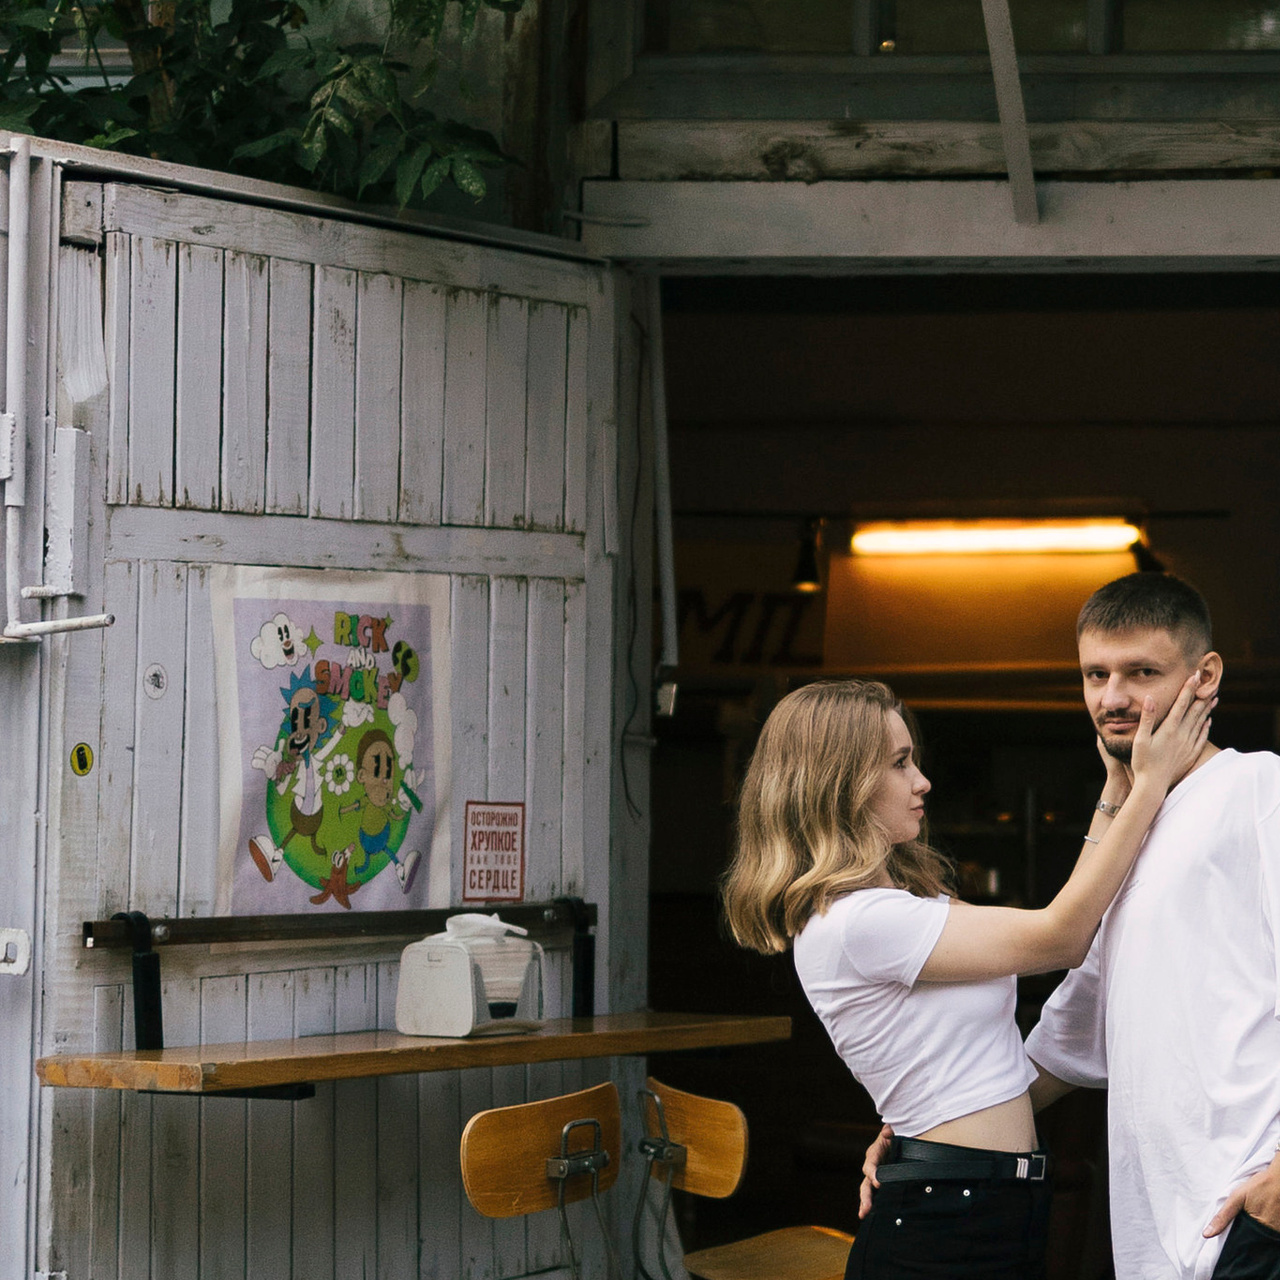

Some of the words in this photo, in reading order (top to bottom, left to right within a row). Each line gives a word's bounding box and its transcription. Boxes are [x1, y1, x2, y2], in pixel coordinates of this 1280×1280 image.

[334, 610, 389, 653] RICK
[346, 646, 376, 670] AND
[314, 659, 403, 710] SMOKEY
[470, 811, 518, 827] ОСТОРОЖНО
[470, 830, 518, 851] ХРУПКОЕ
[469, 854, 488, 865] КАК
[469, 869, 517, 893] СЕРДЦЕ
